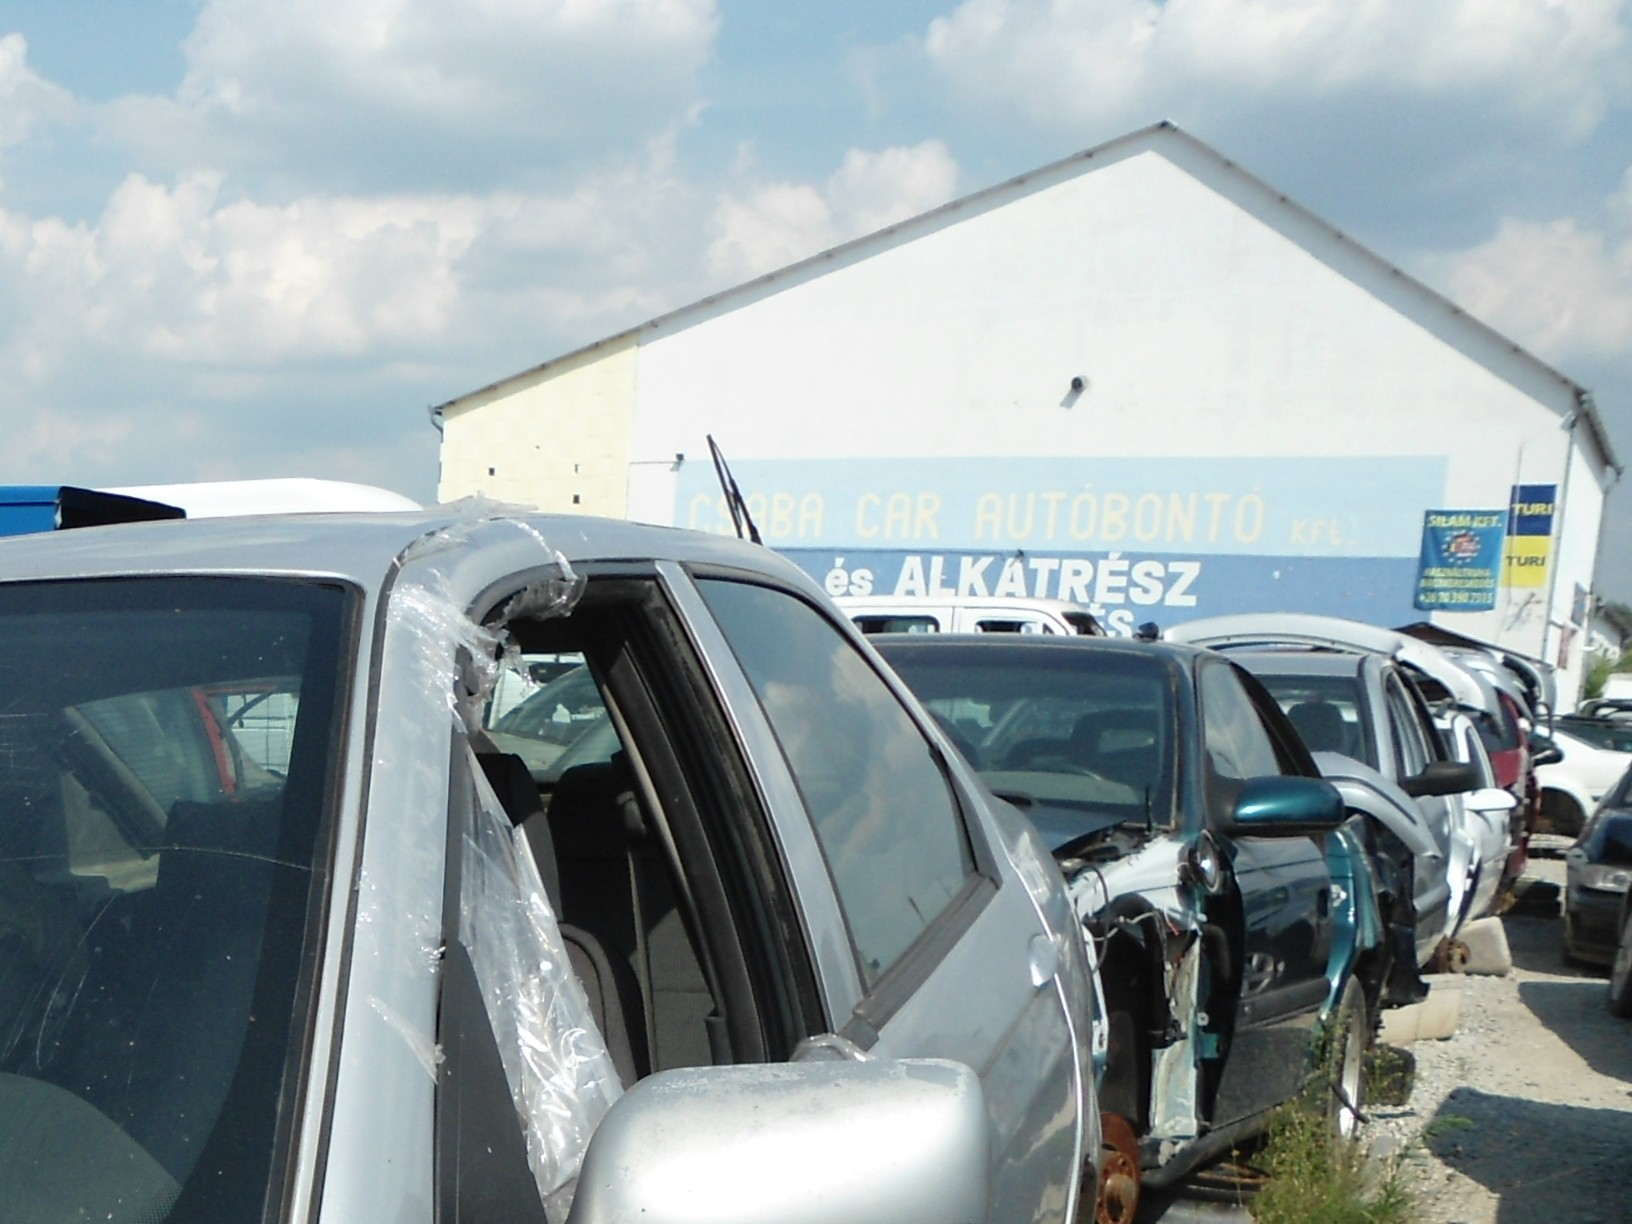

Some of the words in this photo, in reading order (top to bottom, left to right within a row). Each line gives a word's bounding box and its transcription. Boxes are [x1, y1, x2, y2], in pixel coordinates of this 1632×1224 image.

[688, 491, 825, 540] CSABA
[855, 492, 942, 540] CAR
[974, 483, 1266, 544] AUTÓBONTÓ
[1512, 502, 1554, 517] TURI
[1505, 555, 1547, 567] TURI
[824, 556, 874, 597] és
[893, 551, 1202, 607] ALKATRÉSZ
